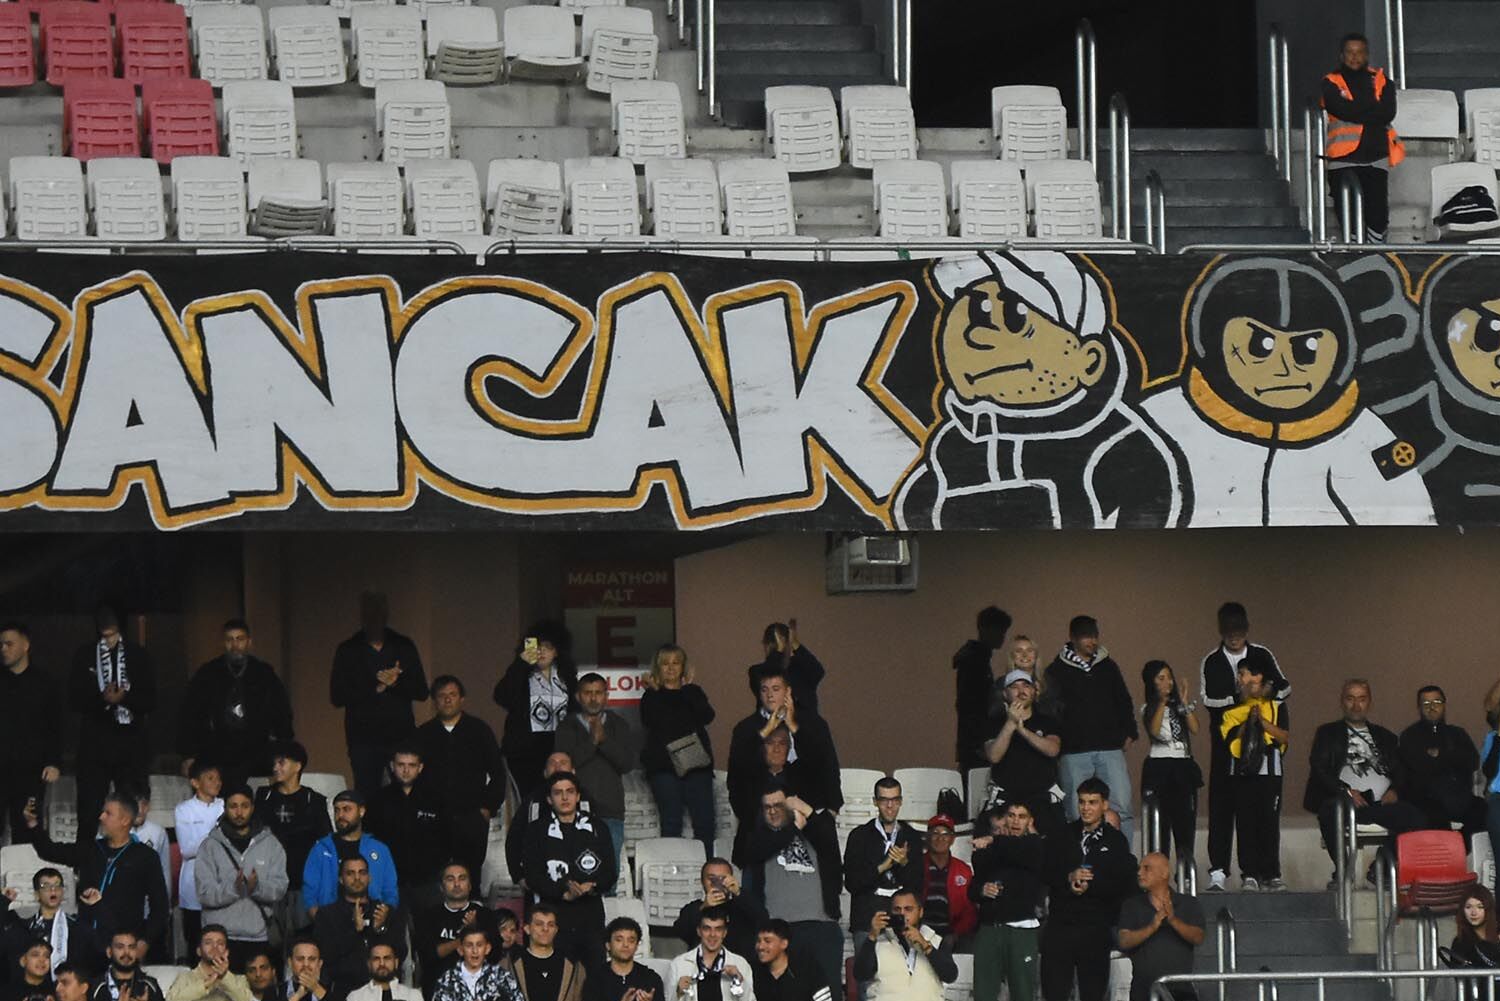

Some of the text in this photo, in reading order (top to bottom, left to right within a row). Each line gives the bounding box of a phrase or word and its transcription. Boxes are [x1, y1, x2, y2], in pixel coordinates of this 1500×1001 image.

[568, 571, 668, 585] MARATHON
[603, 589, 634, 601] ALT
[597, 616, 640, 668] E
